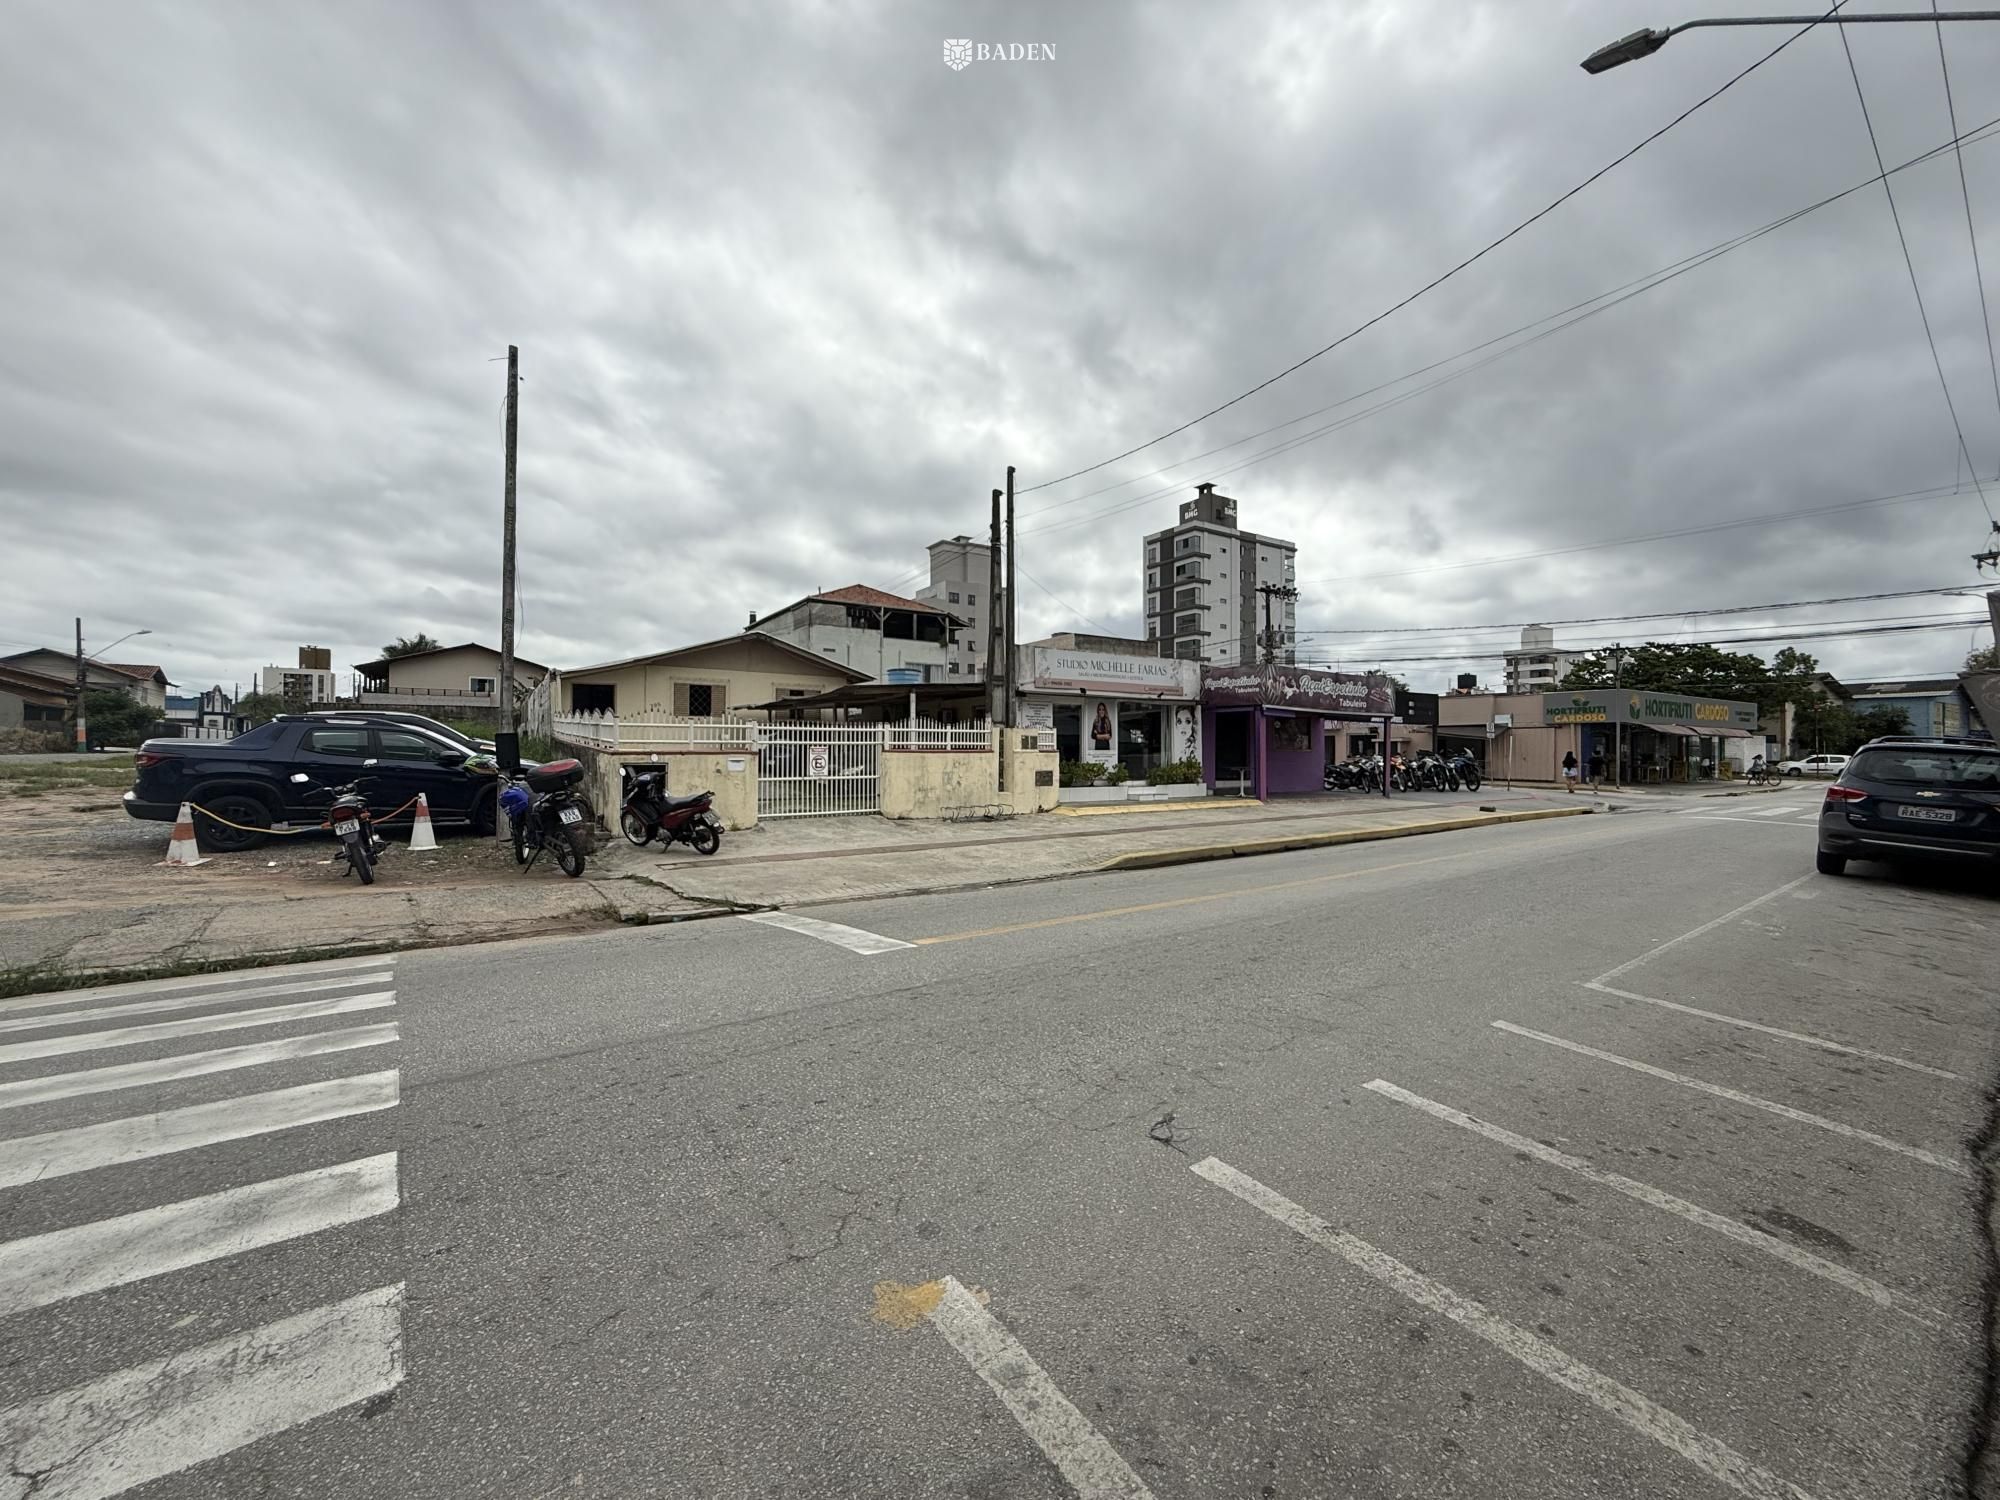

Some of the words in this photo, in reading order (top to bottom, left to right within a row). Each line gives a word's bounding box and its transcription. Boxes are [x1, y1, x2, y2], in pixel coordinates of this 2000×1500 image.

[1056, 658, 1088, 669] STUDIO
[1091, 660, 1134, 674] MICHELLE
[1138, 664, 1168, 676] FARIAS
[1235, 686, 1260, 694] Tabuleiro
[1339, 698, 1367, 708] Tabuleiro
[1546, 706, 1606, 715] HORTIFRUTI
[1645, 699, 1692, 719] HORTIFRUTI
[1695, 702, 1729, 721] CARDOSO
[1554, 713, 1606, 723] CARDOSO
